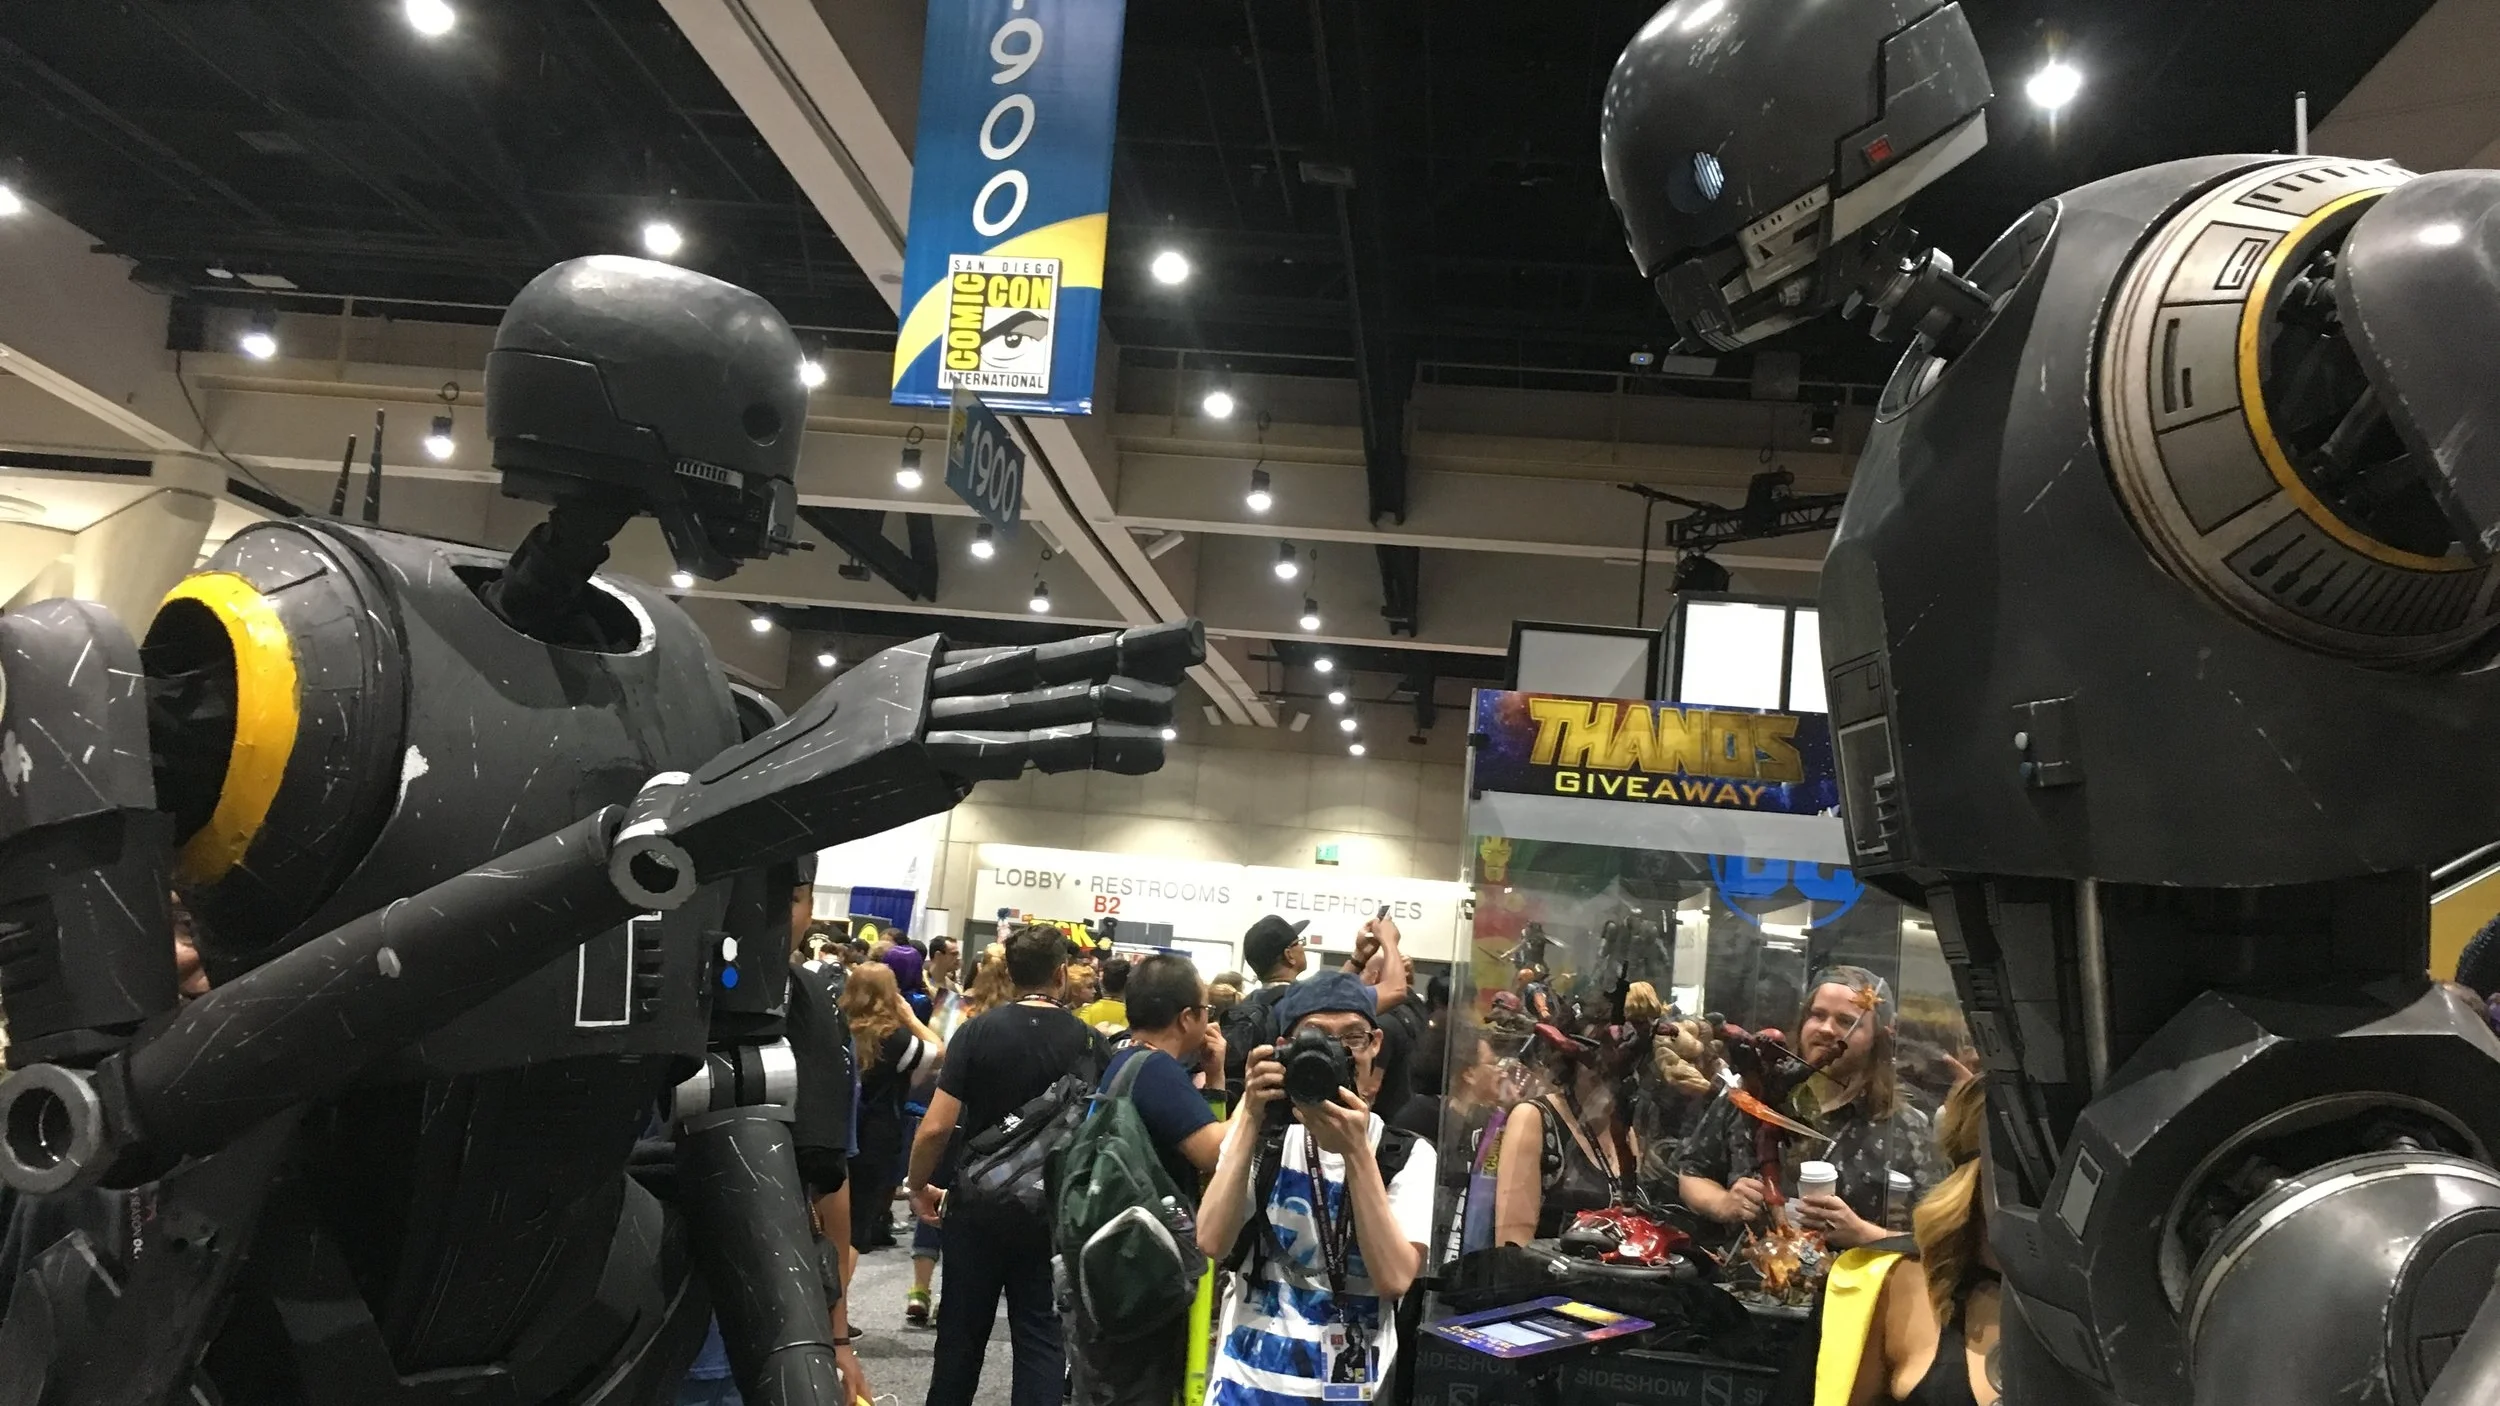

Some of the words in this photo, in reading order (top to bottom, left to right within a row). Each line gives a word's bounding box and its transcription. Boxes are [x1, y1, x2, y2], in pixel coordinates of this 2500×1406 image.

[973, 0, 1042, 236] 900
[954, 260, 985, 272] SAN
[1002, 262, 1054, 275] DIEGO
[987, 275, 1053, 310] CON
[946, 273, 986, 371] COMIC
[943, 371, 1044, 389] INTERNATIONAL
[967, 420, 1018, 523] 1900
[1529, 697, 1804, 784] THANOS
[1555, 771, 1767, 806] GIVEAWAY
[995, 868, 1066, 889] LOBBY
[1090, 876, 1230, 904] RESTROOMS
[1272, 890, 1422, 920] TELEPHOES
[1094, 895, 1121, 914] B2
[1573, 1367, 1690, 1397] SIDESHOW
